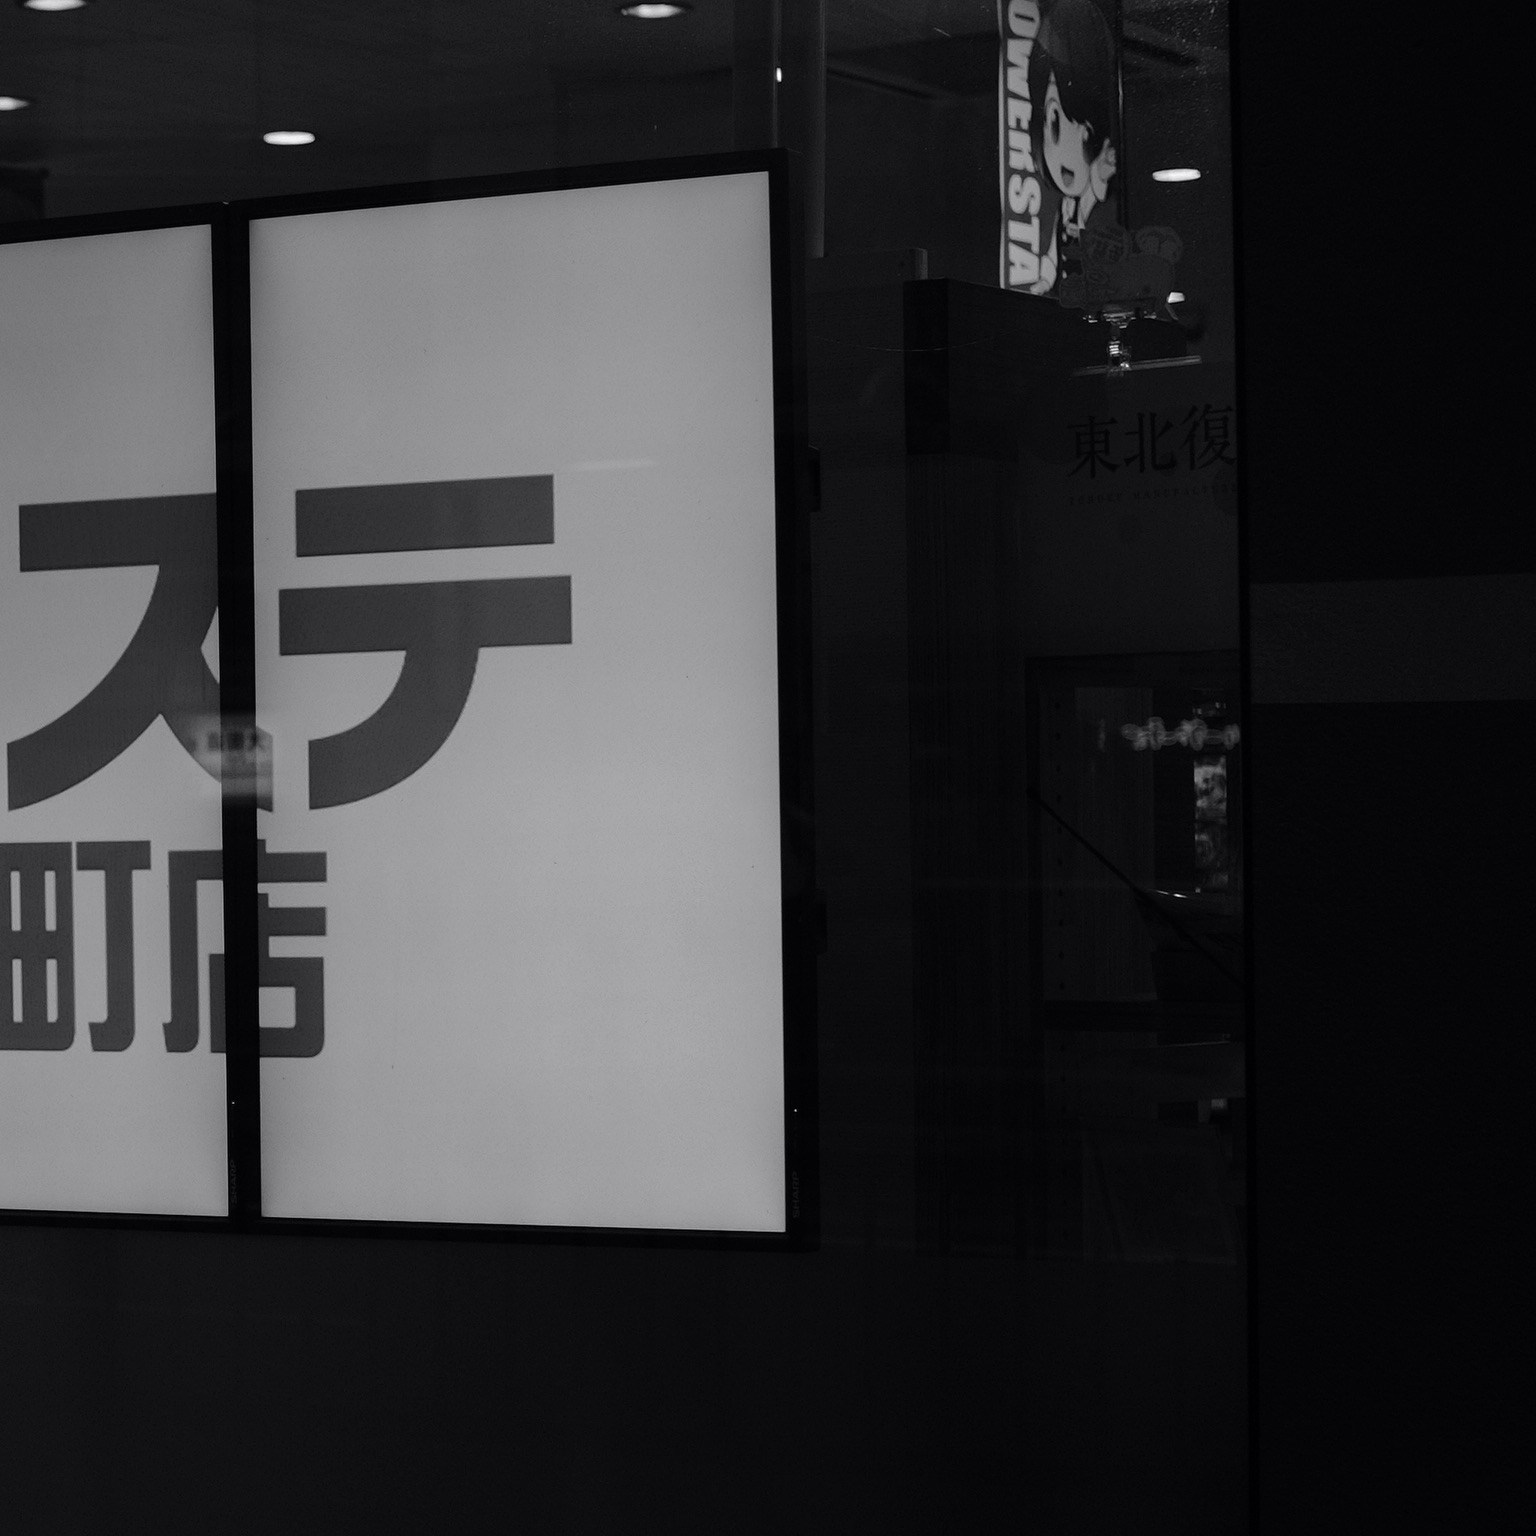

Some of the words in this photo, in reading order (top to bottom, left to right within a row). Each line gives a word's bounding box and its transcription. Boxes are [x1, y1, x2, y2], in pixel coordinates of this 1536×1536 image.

[1067, 403, 1238, 479] 東北復
[791, 1170, 801, 1219] SHARP
